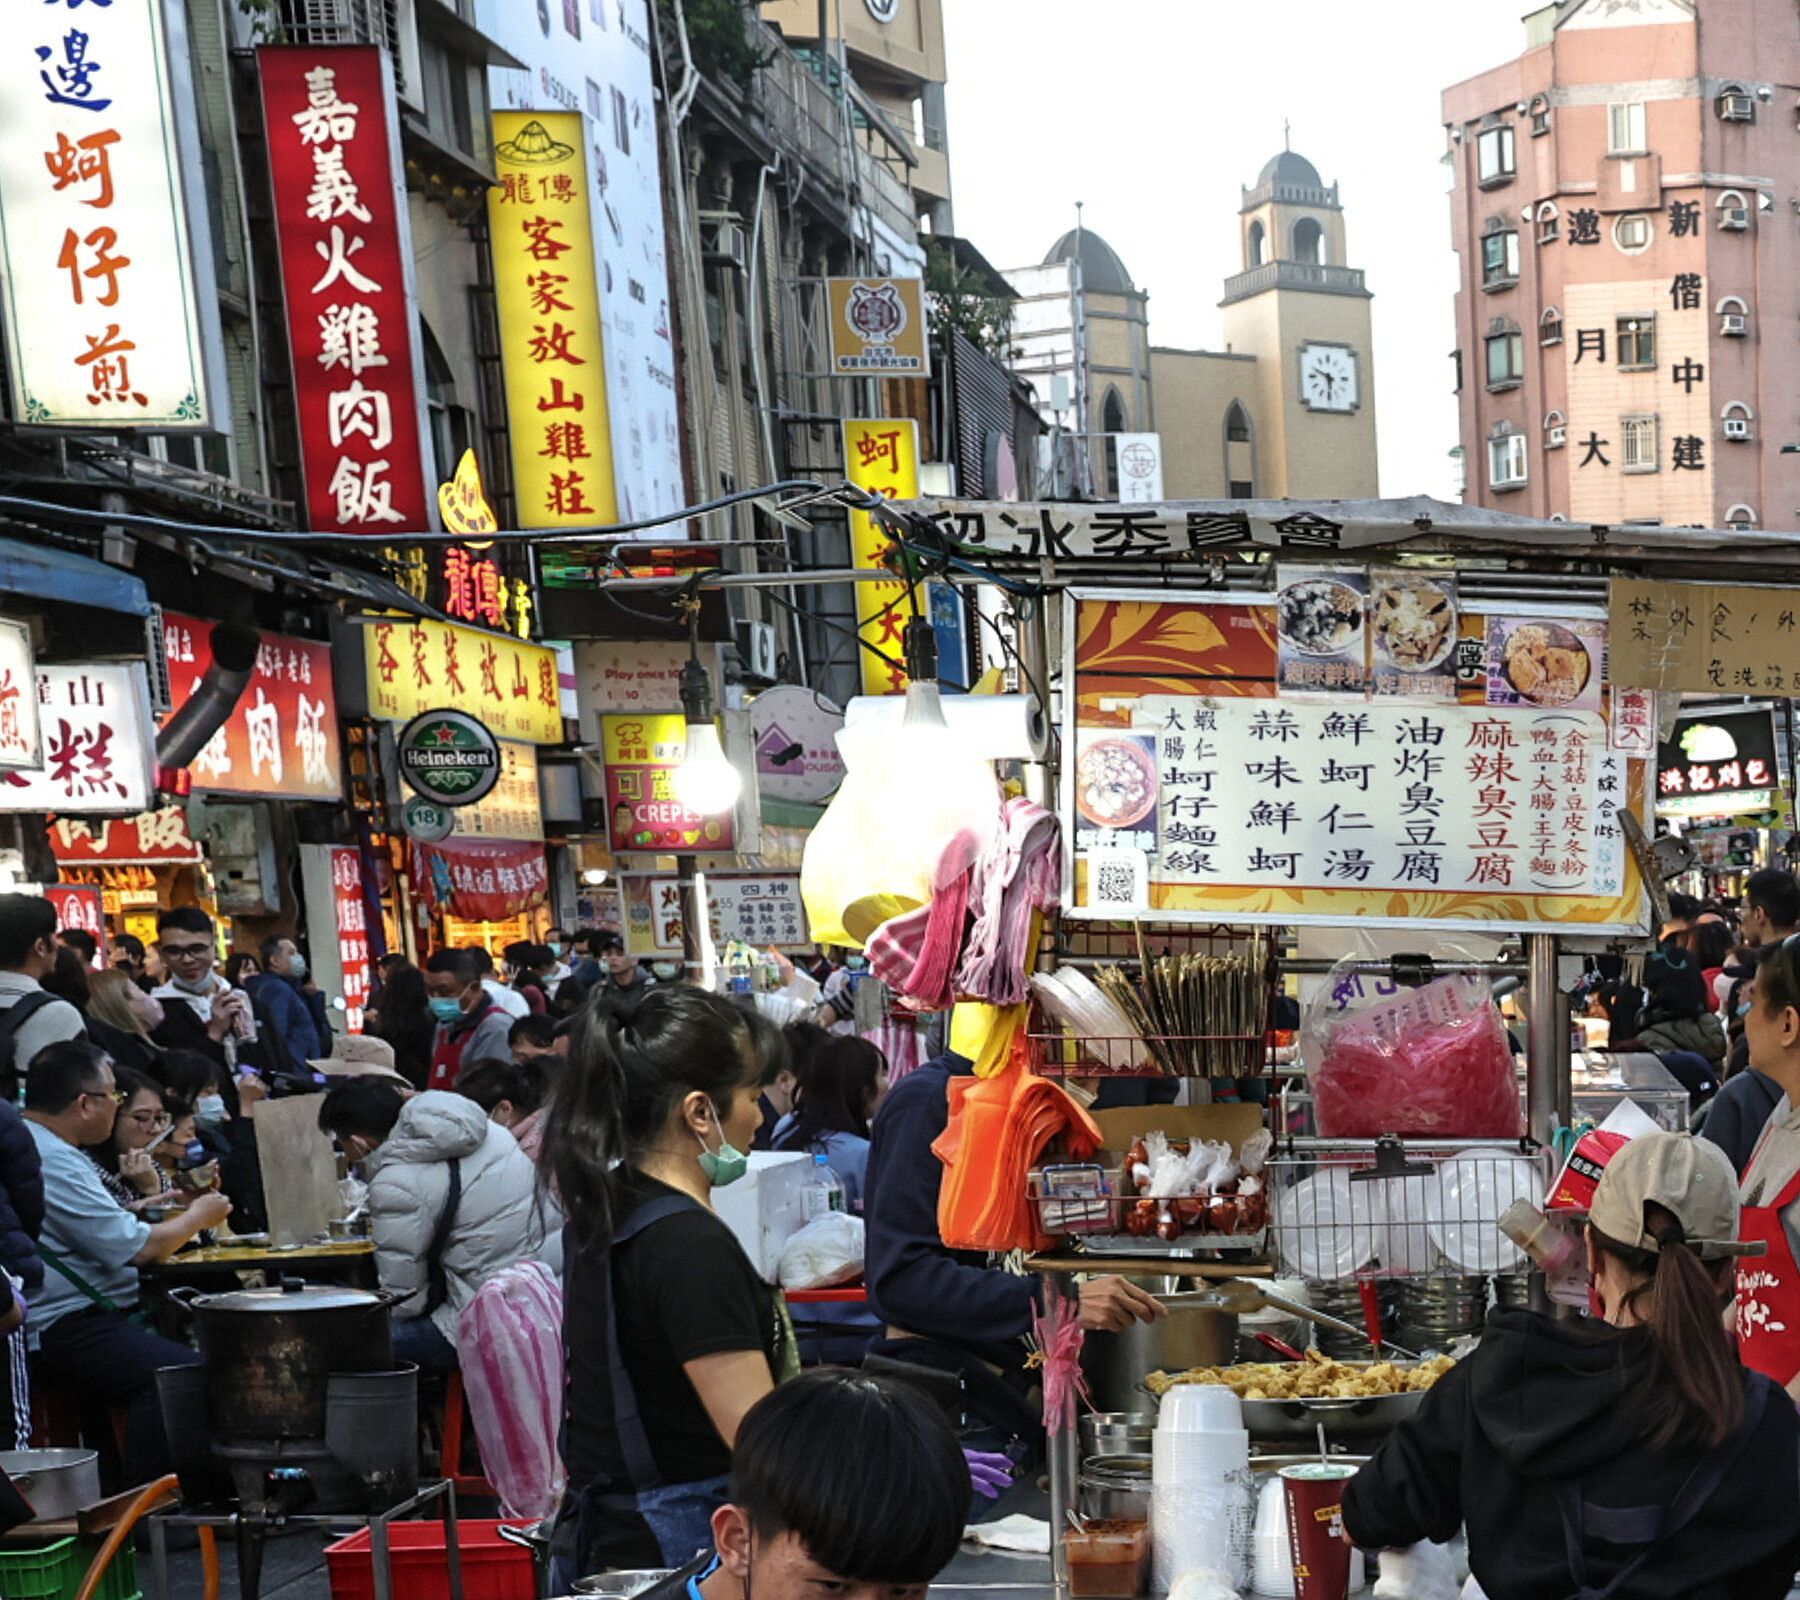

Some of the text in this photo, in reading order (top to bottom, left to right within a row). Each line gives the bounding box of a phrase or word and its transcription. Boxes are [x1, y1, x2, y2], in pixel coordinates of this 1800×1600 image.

[35, 0, 147, 406] 邊蚵仔煎
[292, 66, 406, 525] 嘉義火雞肉飯
[522, 216, 595, 515] 客家放山雞莊
[1669, 200, 1705, 529] 新偕中建
[408, 750, 490, 767] Heineken
[416, 809, 434, 825] 18
[1245, 709, 1303, 880] 蒜味鮮蚵
[1318, 711, 1375, 882] 鮮蚵仁湯
[1392, 716, 1447, 884] 油炸臭豆腐
[1465, 717, 1520, 886] 麻辣臭豆腐
